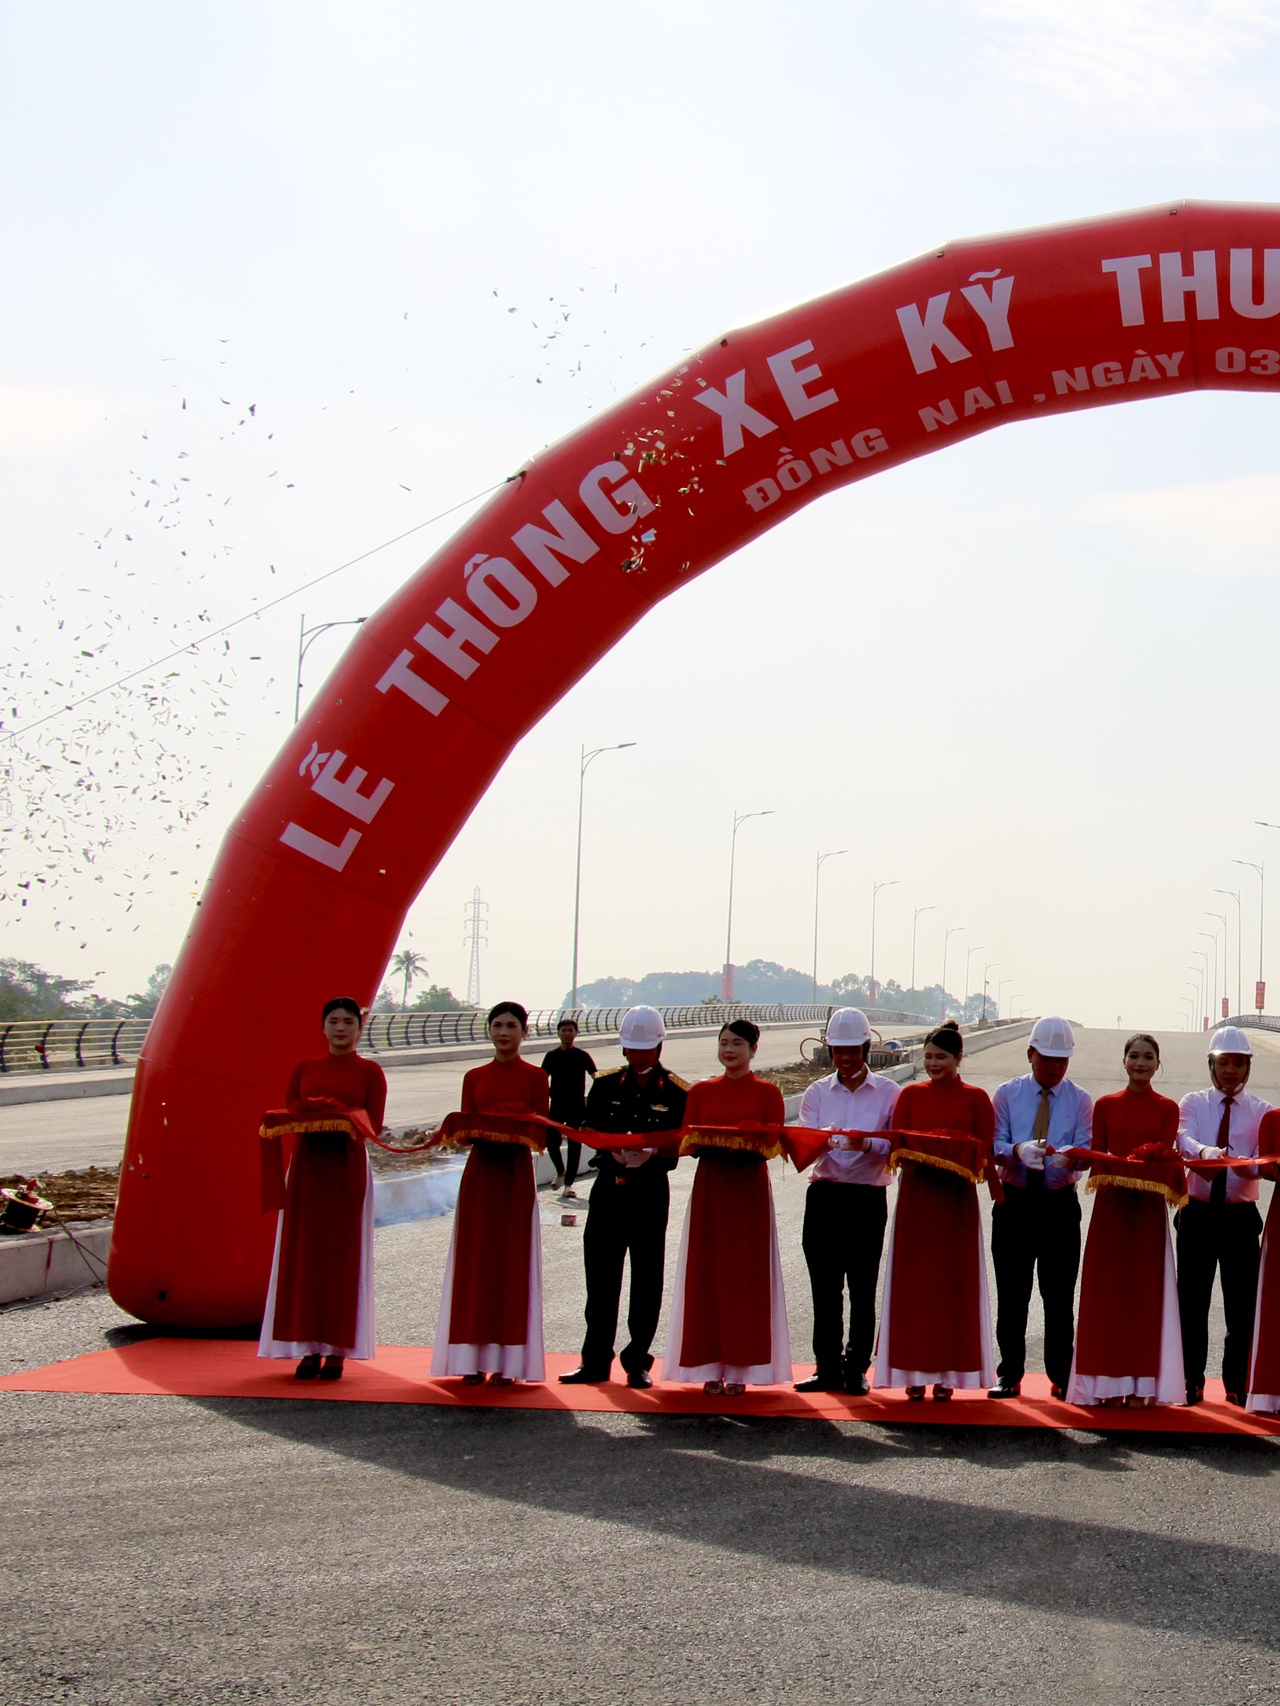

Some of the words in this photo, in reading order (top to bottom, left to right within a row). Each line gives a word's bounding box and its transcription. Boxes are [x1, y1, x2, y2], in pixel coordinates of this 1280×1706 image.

[279, 741, 395, 871] LỄ
[375, 460, 657, 717] THÔNG
[693, 339, 838, 457] XE
[896, 269, 1014, 374] KỸ
[743, 429, 888, 512] ĐỒNG
[1215, 346, 1280, 375] 03
